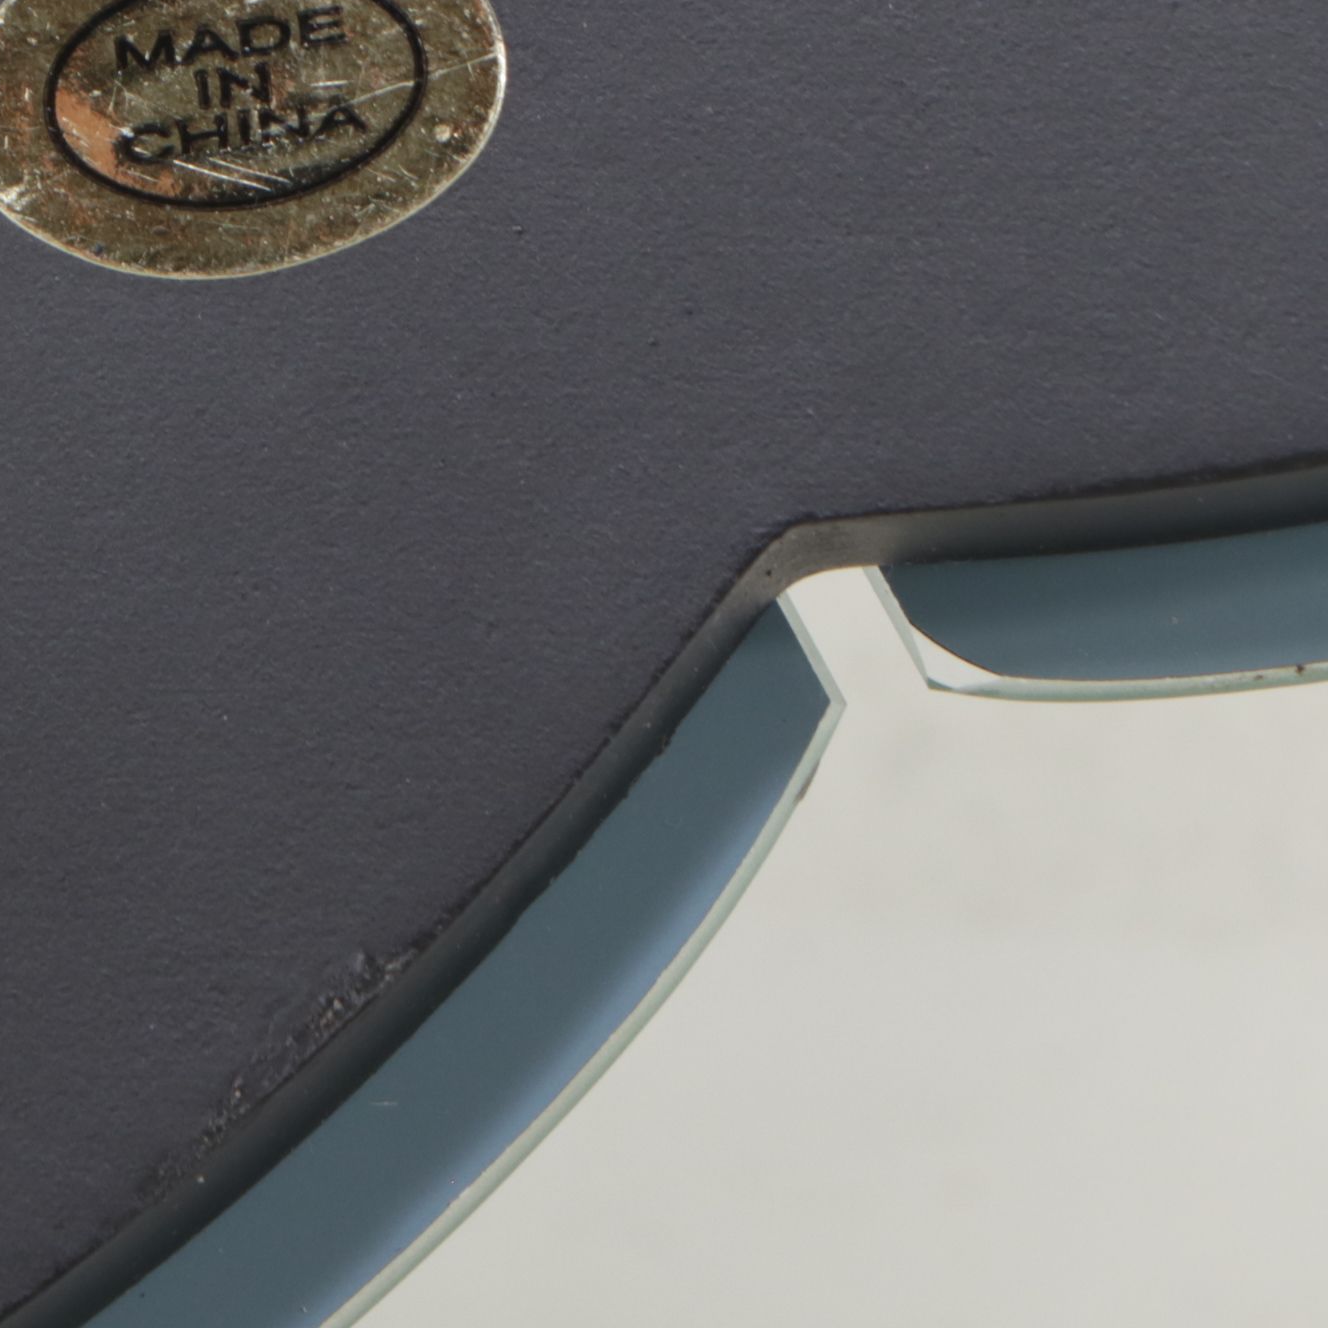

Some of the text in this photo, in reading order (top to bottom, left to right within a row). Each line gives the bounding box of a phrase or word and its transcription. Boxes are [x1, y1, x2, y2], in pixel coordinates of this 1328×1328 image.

[114, 5, 347, 71] MADE
[193, 61, 271, 110] IN
[116, 93, 368, 164] CHINA
